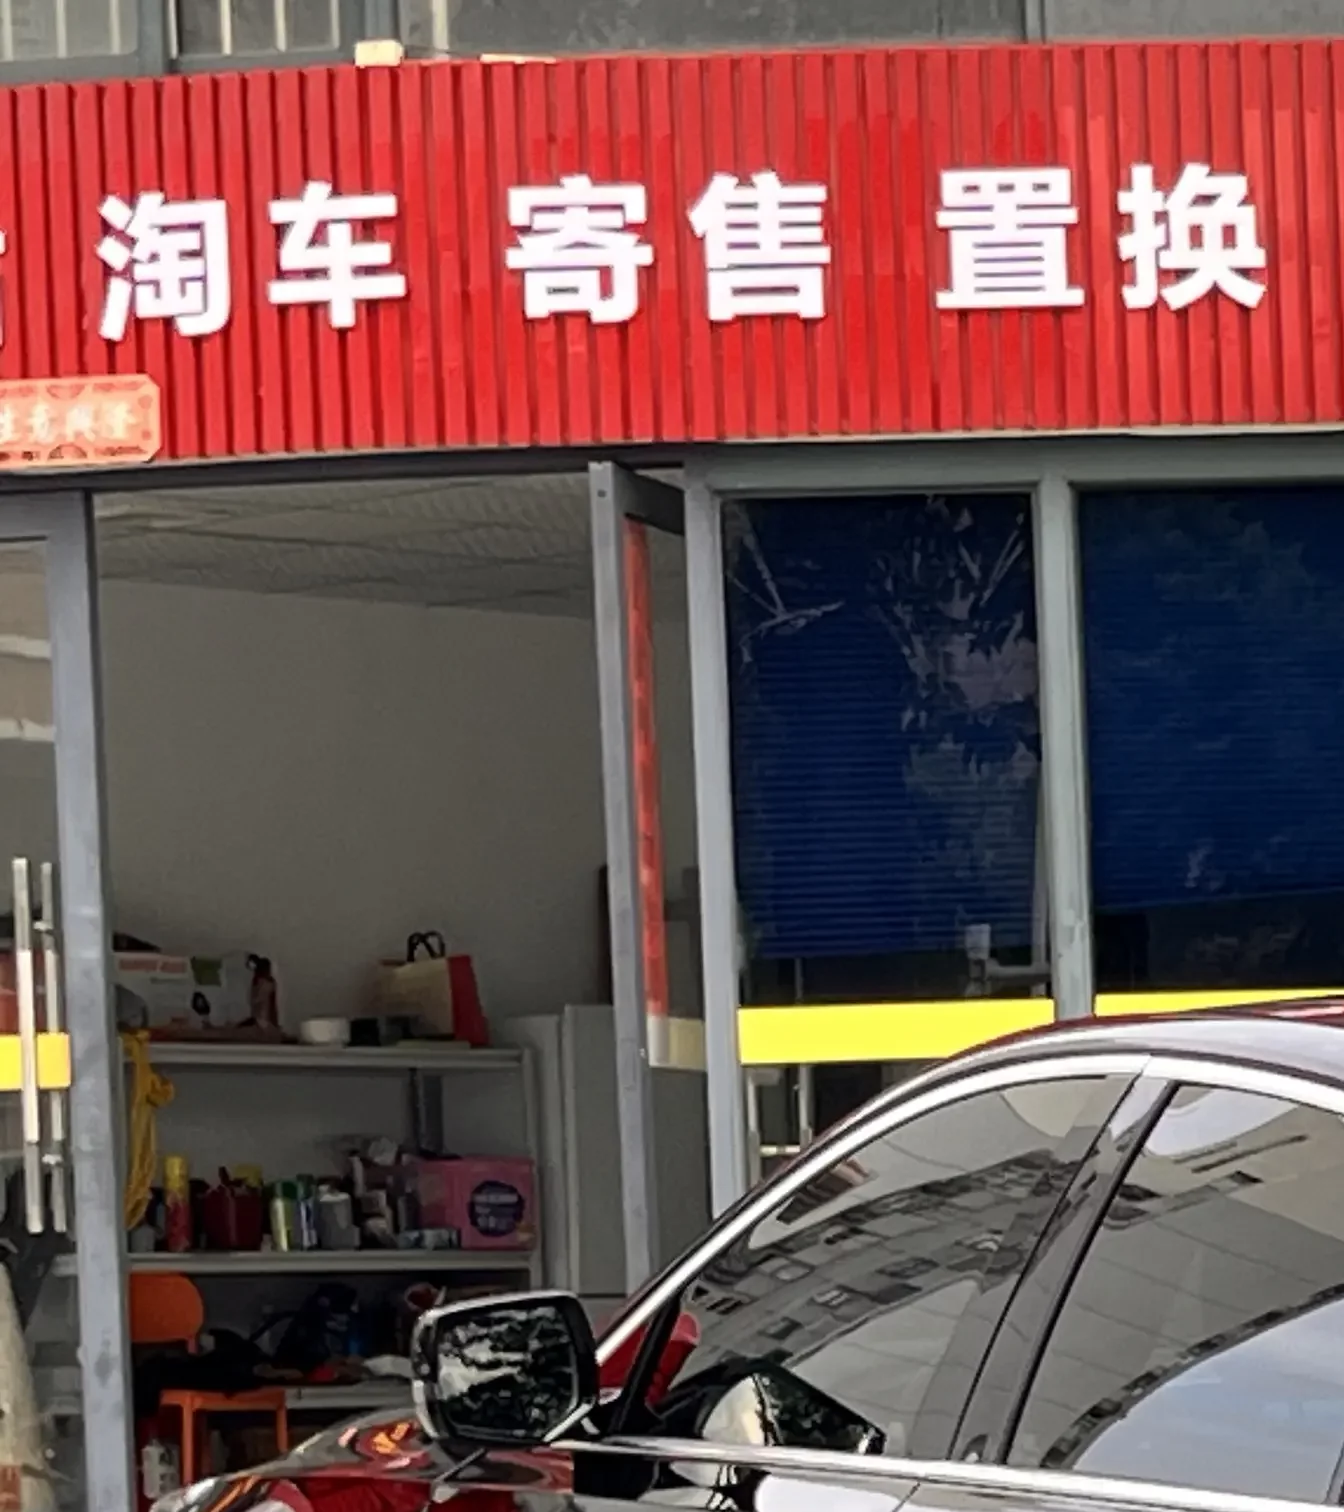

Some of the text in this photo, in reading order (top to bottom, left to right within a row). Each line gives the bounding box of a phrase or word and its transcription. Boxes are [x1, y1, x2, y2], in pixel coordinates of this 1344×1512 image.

[95, 181, 407, 341] 淘车
[505, 170, 832, 323] 寄售
[936, 162, 1267, 311] 置换
